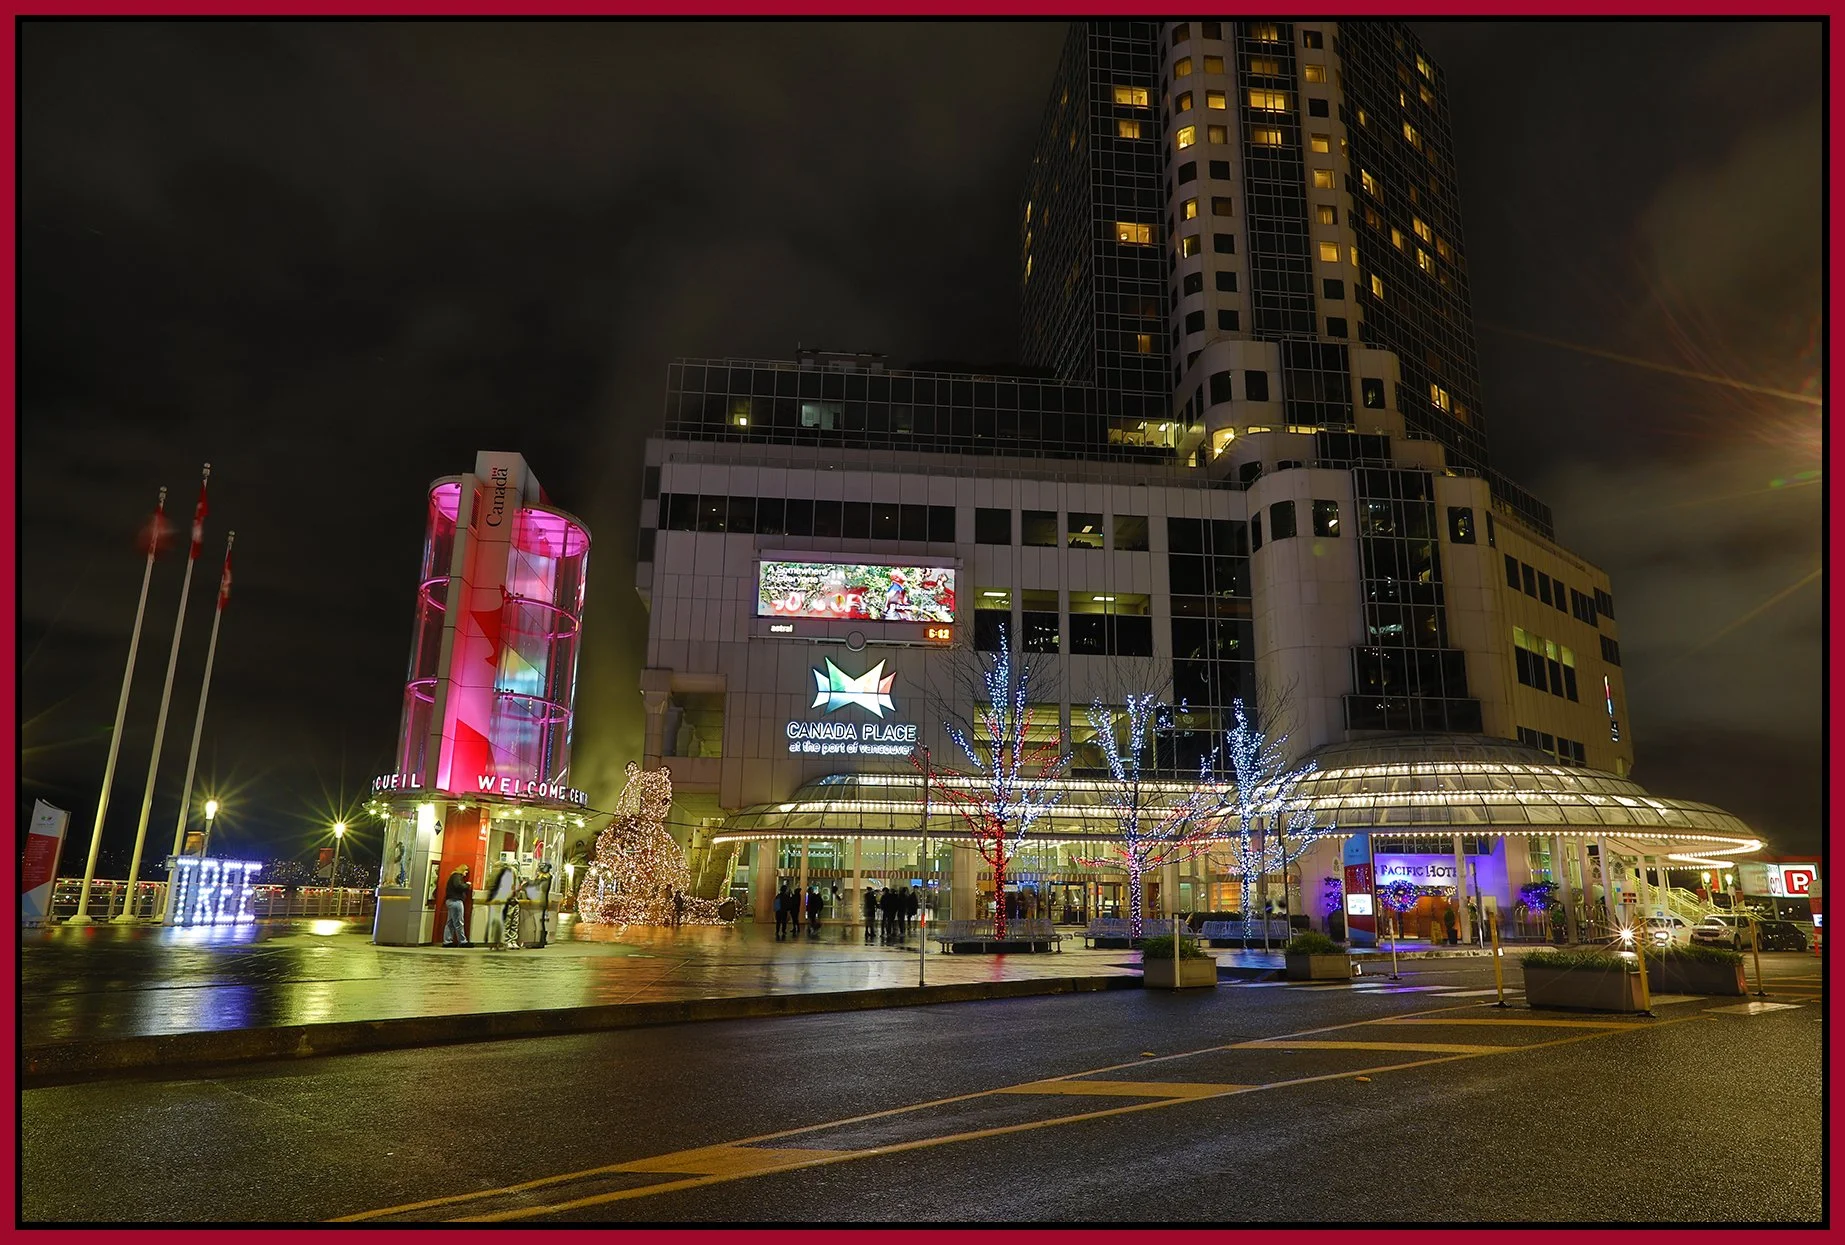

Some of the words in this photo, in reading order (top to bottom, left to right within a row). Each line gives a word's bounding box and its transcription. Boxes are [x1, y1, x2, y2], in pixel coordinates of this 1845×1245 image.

[486, 467, 508, 527] Canada
[770, 624, 793, 633] astral
[787, 721, 857, 740] CANADA
[862, 723, 917, 742] PLACE
[788, 741, 801, 753] at
[803, 740, 821, 753] the
[822, 742, 846, 755] port
[847, 741, 859, 754] of
[859, 743, 914, 756] vancouver
[371, 773, 421, 795] CUEIL
[477, 775, 567, 801] WELCOME
[1380, 864, 1424, 878] PACIFIC
[173, 857, 262, 923] TREE
